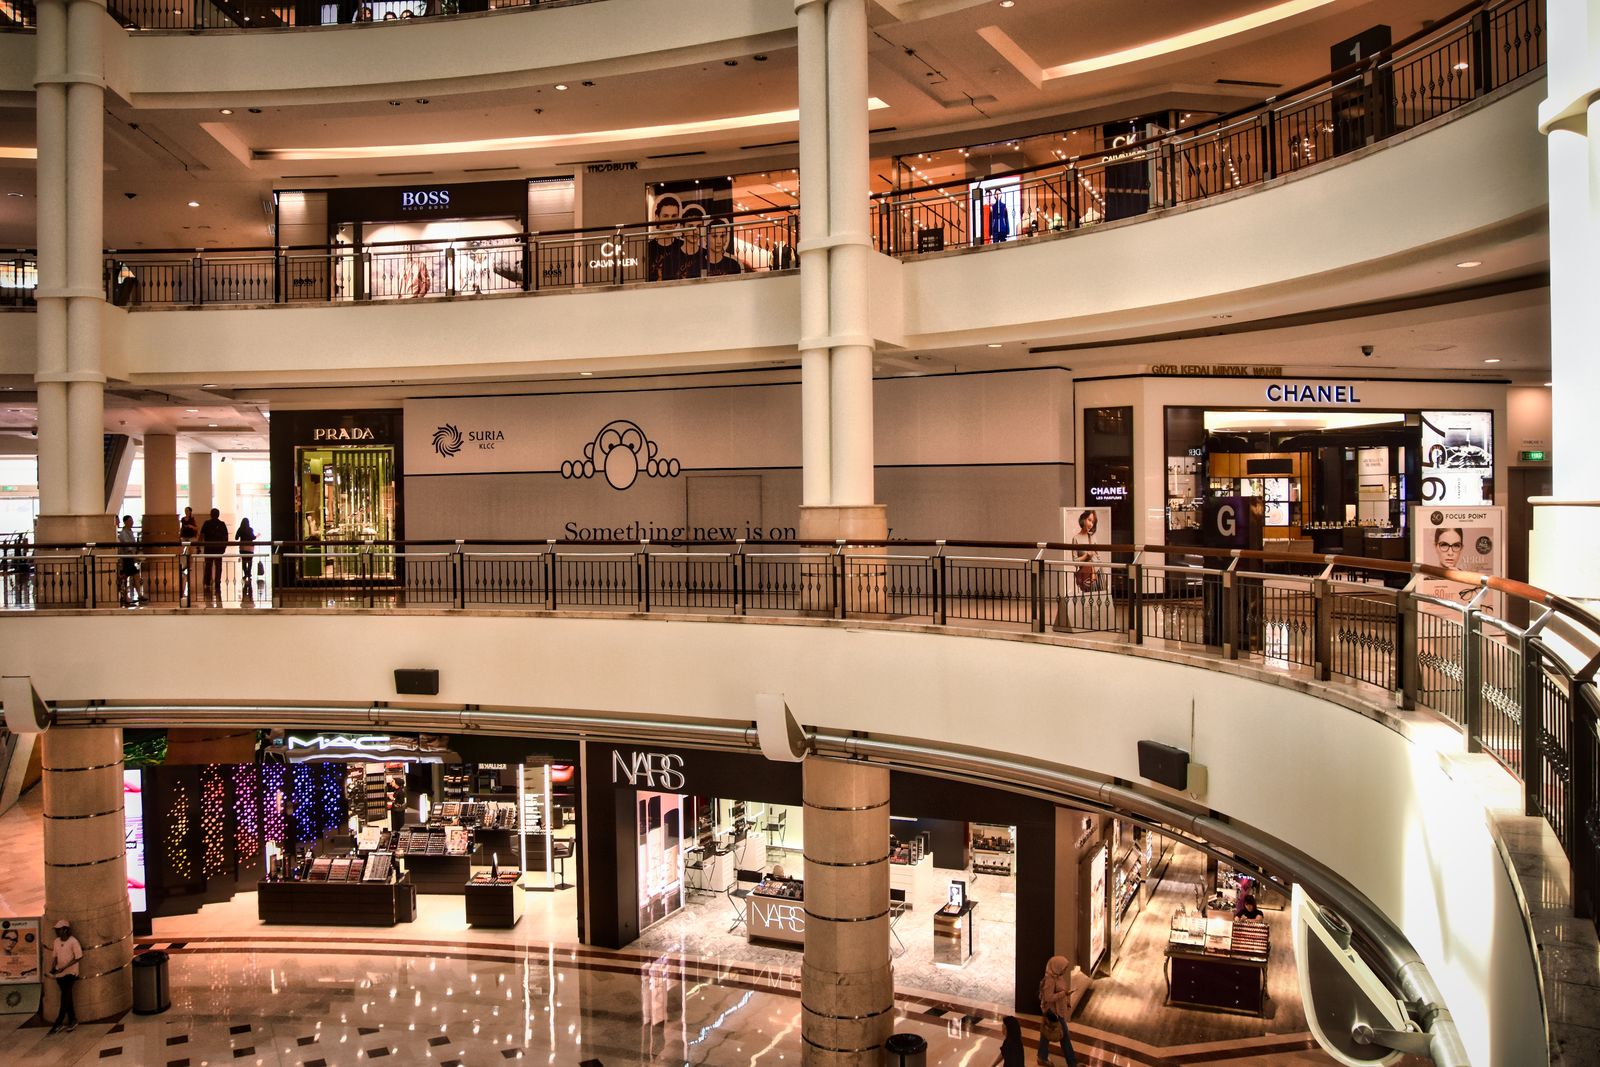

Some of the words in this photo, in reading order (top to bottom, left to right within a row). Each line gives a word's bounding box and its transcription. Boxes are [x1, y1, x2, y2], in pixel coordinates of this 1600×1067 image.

[1350, 42, 1361, 63] 1
[402, 191, 450, 206] BOSS
[601, 241, 626, 257] CK
[590, 260, 615, 269] CALVIN
[617, 258, 638, 267] KLEIN
[1152, 365, 1178, 375] G07B
[1181, 365, 1210, 375] KEDAI
[1213, 366, 1248, 376] MINYAK
[1253, 367, 1282, 377] WANGI
[1266, 384, 1361, 402] CHANEL
[314, 427, 375, 440] PRADA
[468, 431, 504, 441] SURIA
[1090, 487, 1128, 495] CHANEL
[1217, 505, 1236, 537] G
[565, 521, 685, 547] Something
[694, 527, 737, 541] new
[746, 521, 763, 541] is
[769, 527, 797, 541] on
[612, 749, 685, 790] NARS
[752, 901, 805, 933] NARS
